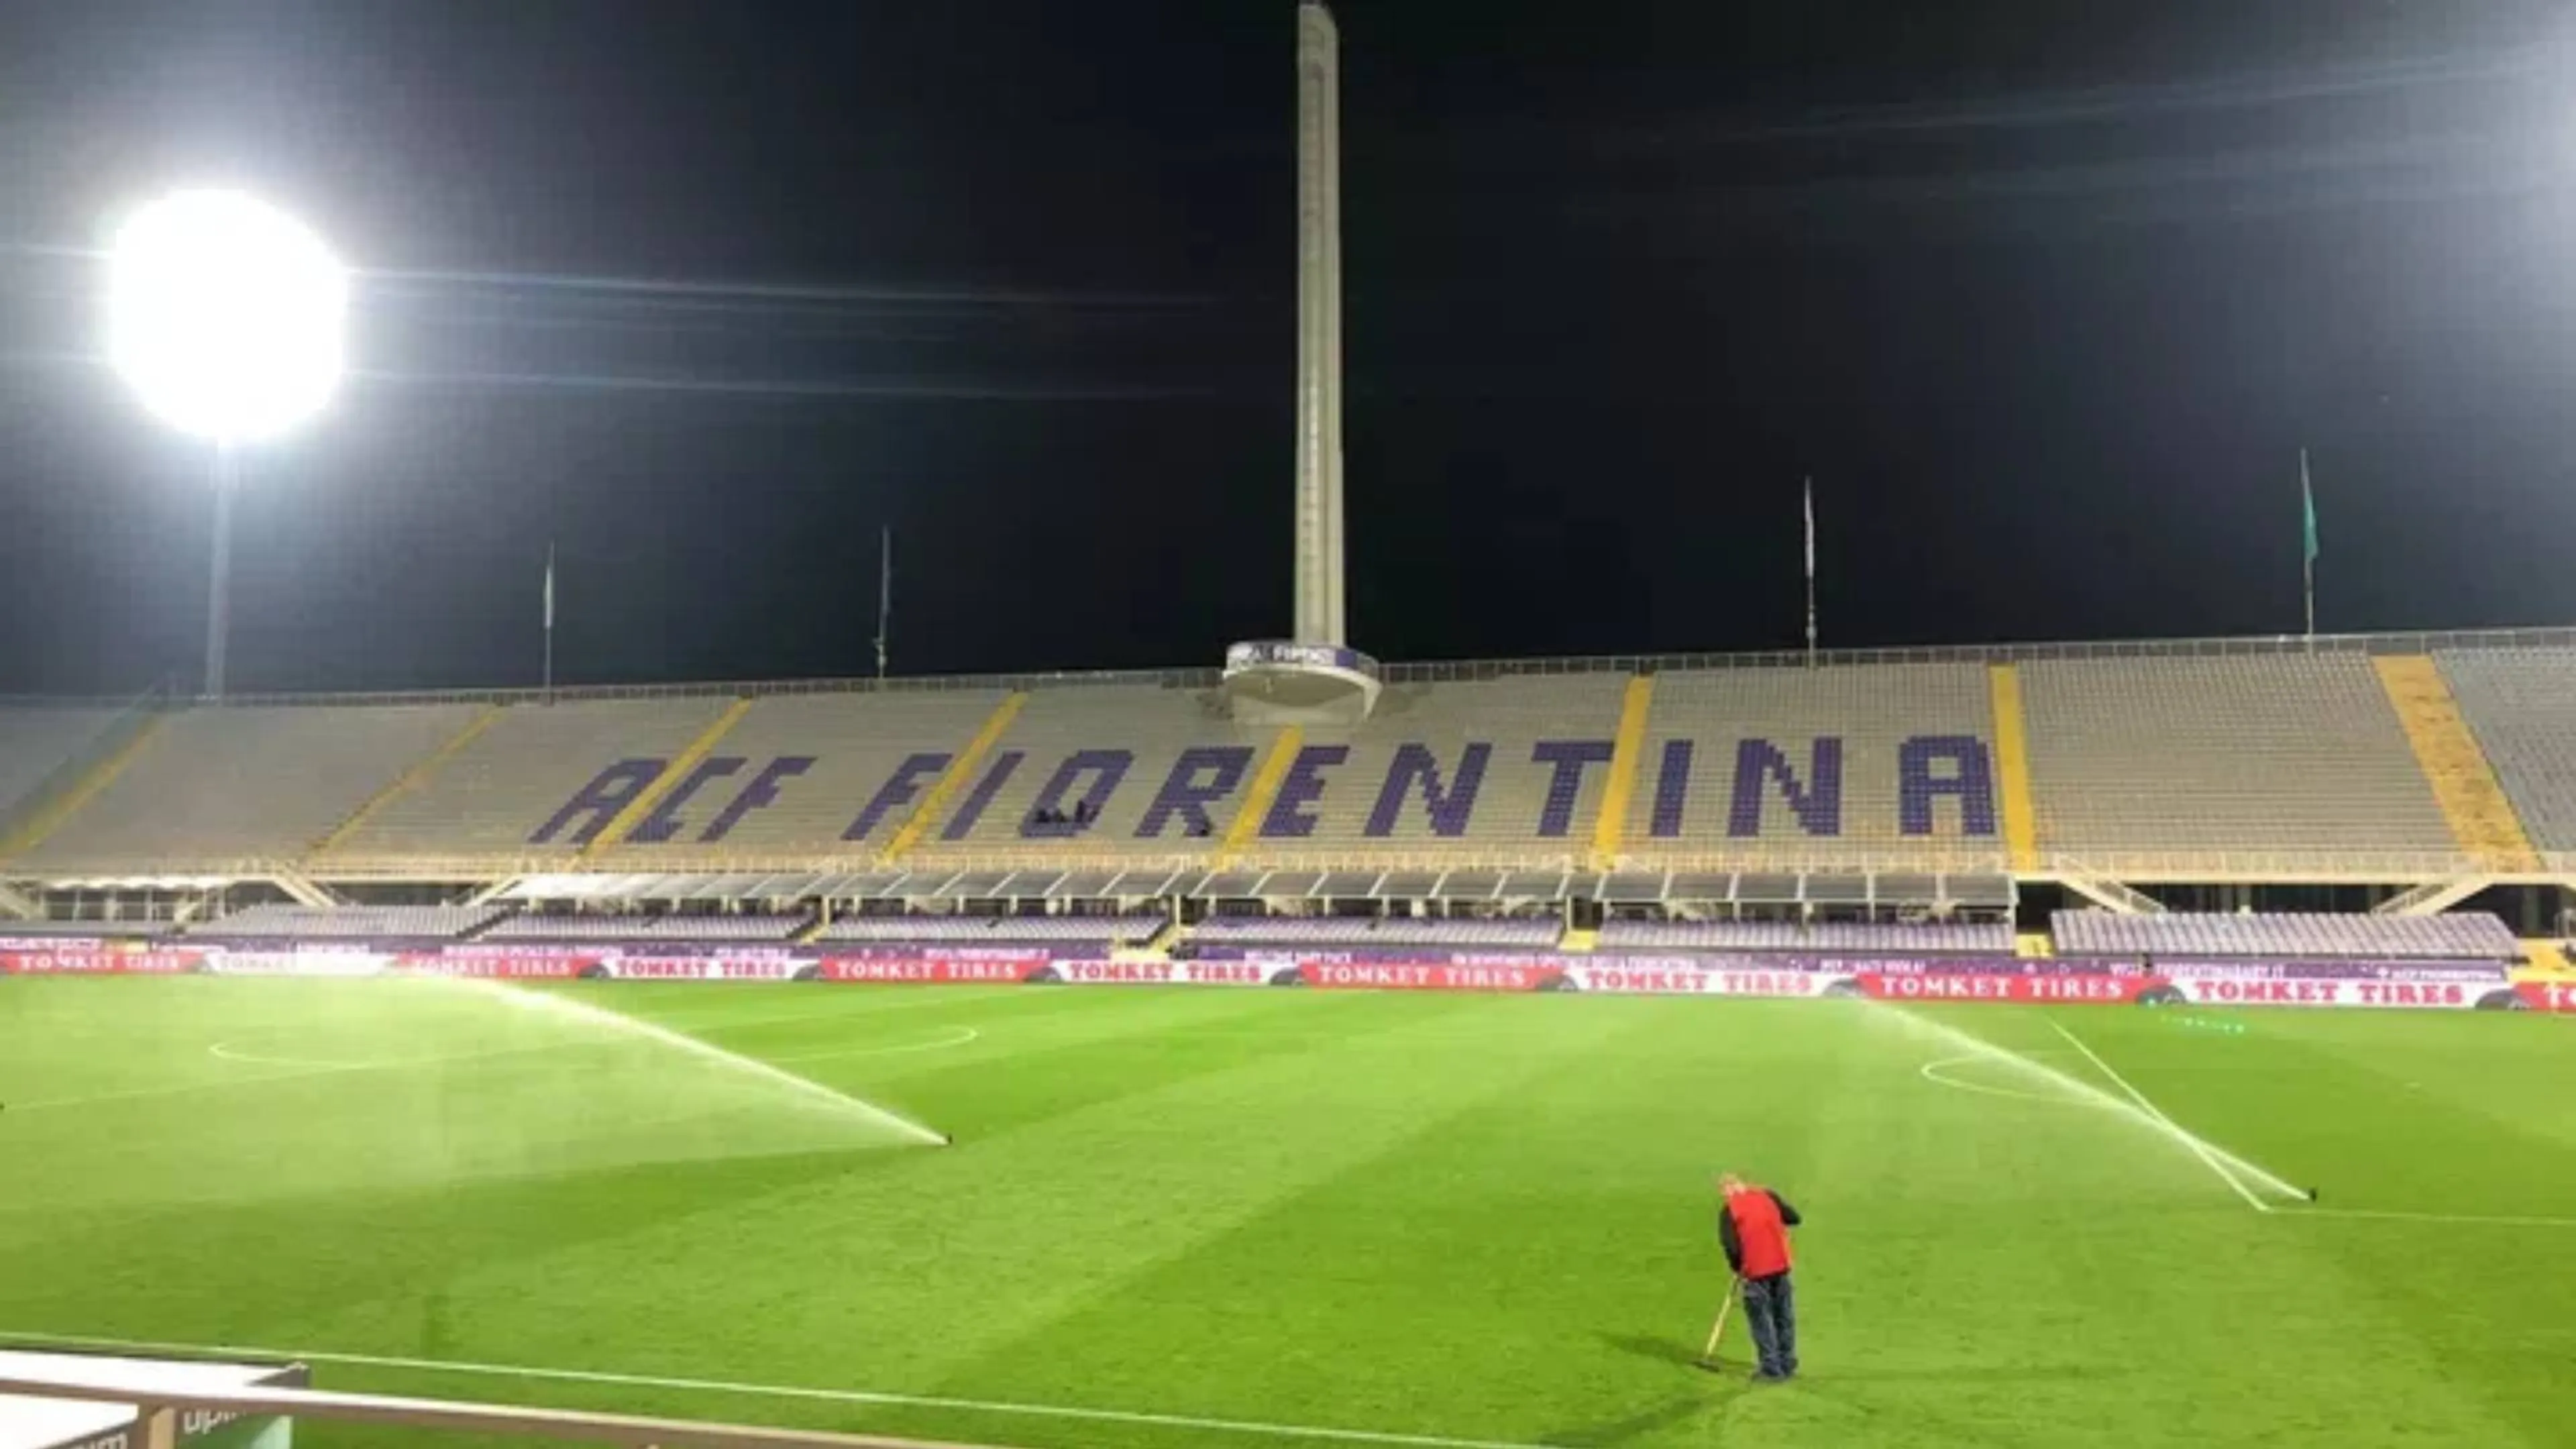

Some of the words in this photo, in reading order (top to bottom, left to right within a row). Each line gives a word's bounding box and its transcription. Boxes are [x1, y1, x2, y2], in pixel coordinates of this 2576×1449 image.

[527, 756, 818, 843] ACF
[839, 735, 1996, 841] FIORENTINA
[837, 961, 934, 978] TOMKET
[948, 961, 1017, 979] TIRES
[1068, 963, 1173, 979] TOMKET
[1186, 963, 1261, 981] TIRES
[1318, 966, 1430, 984] TOMKET
[1445, 967, 1526, 986] TIRES
[1586, 971, 1708, 990] TOMKET
[1723, 974, 1813, 992] TIRES
[1881, 977, 2012, 997] TOMKET
[2031, 979, 2124, 998] TIRES
[2194, 980, 2341, 1002] TOMKET
[2358, 983, 2465, 1004] TIRES
